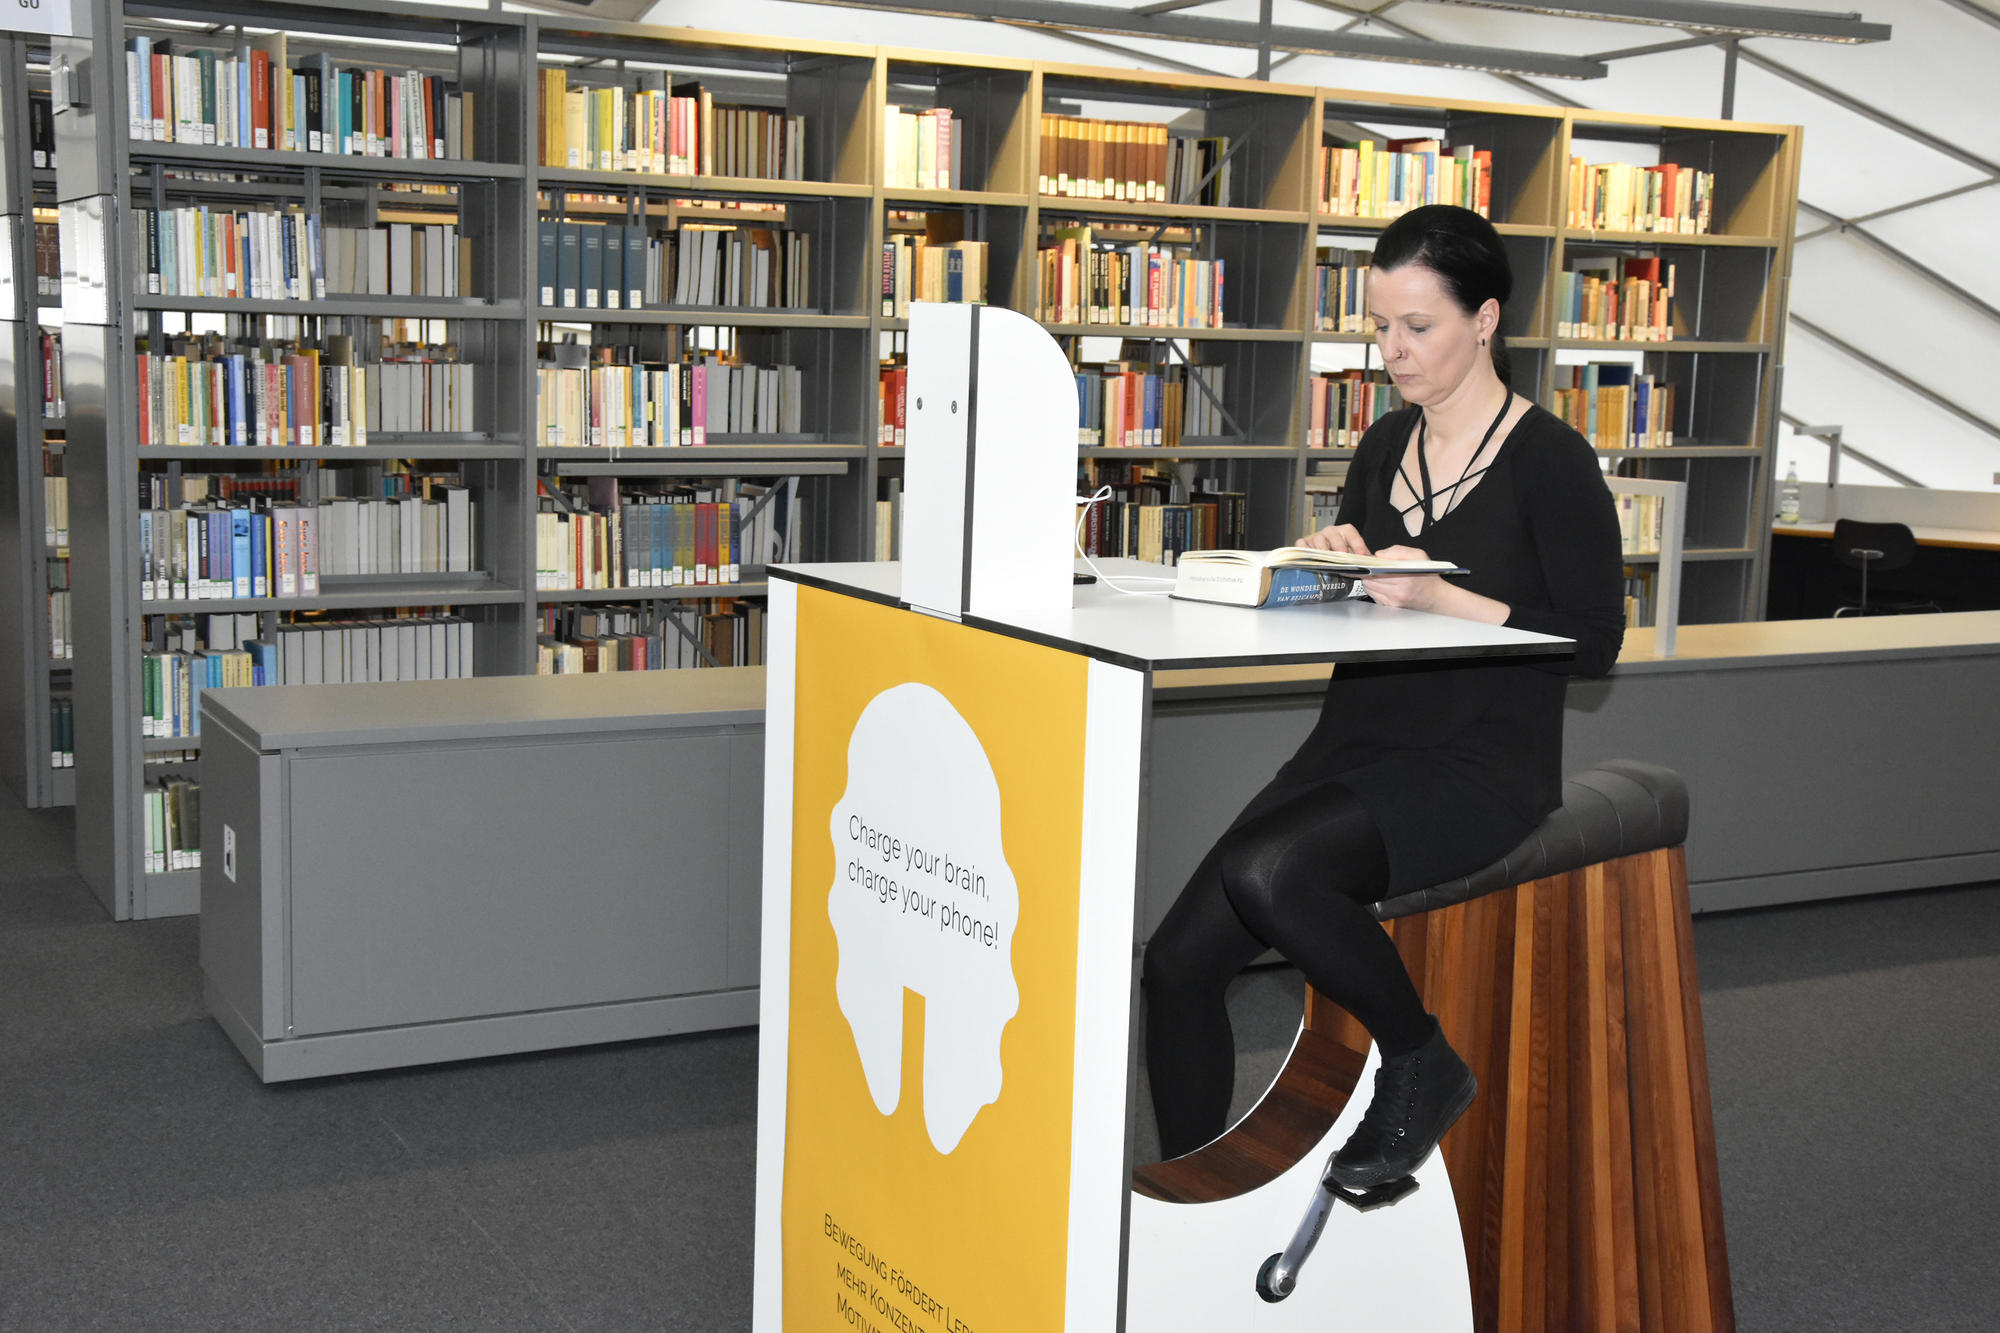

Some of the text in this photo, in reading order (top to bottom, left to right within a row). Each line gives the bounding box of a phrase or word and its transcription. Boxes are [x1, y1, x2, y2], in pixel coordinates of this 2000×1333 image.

[1280, 582, 1346, 594] DE WONDERE WERELD
[849, 815, 990, 902] Charge your brain,
[849, 858, 999, 950] charge your phone!
[824, 1213, 974, 1333] BEWEGUNG FÖRDERT LER
[837, 1262, 867, 1301] MEHR
[837, 1292, 882, 1333] MOTIV
